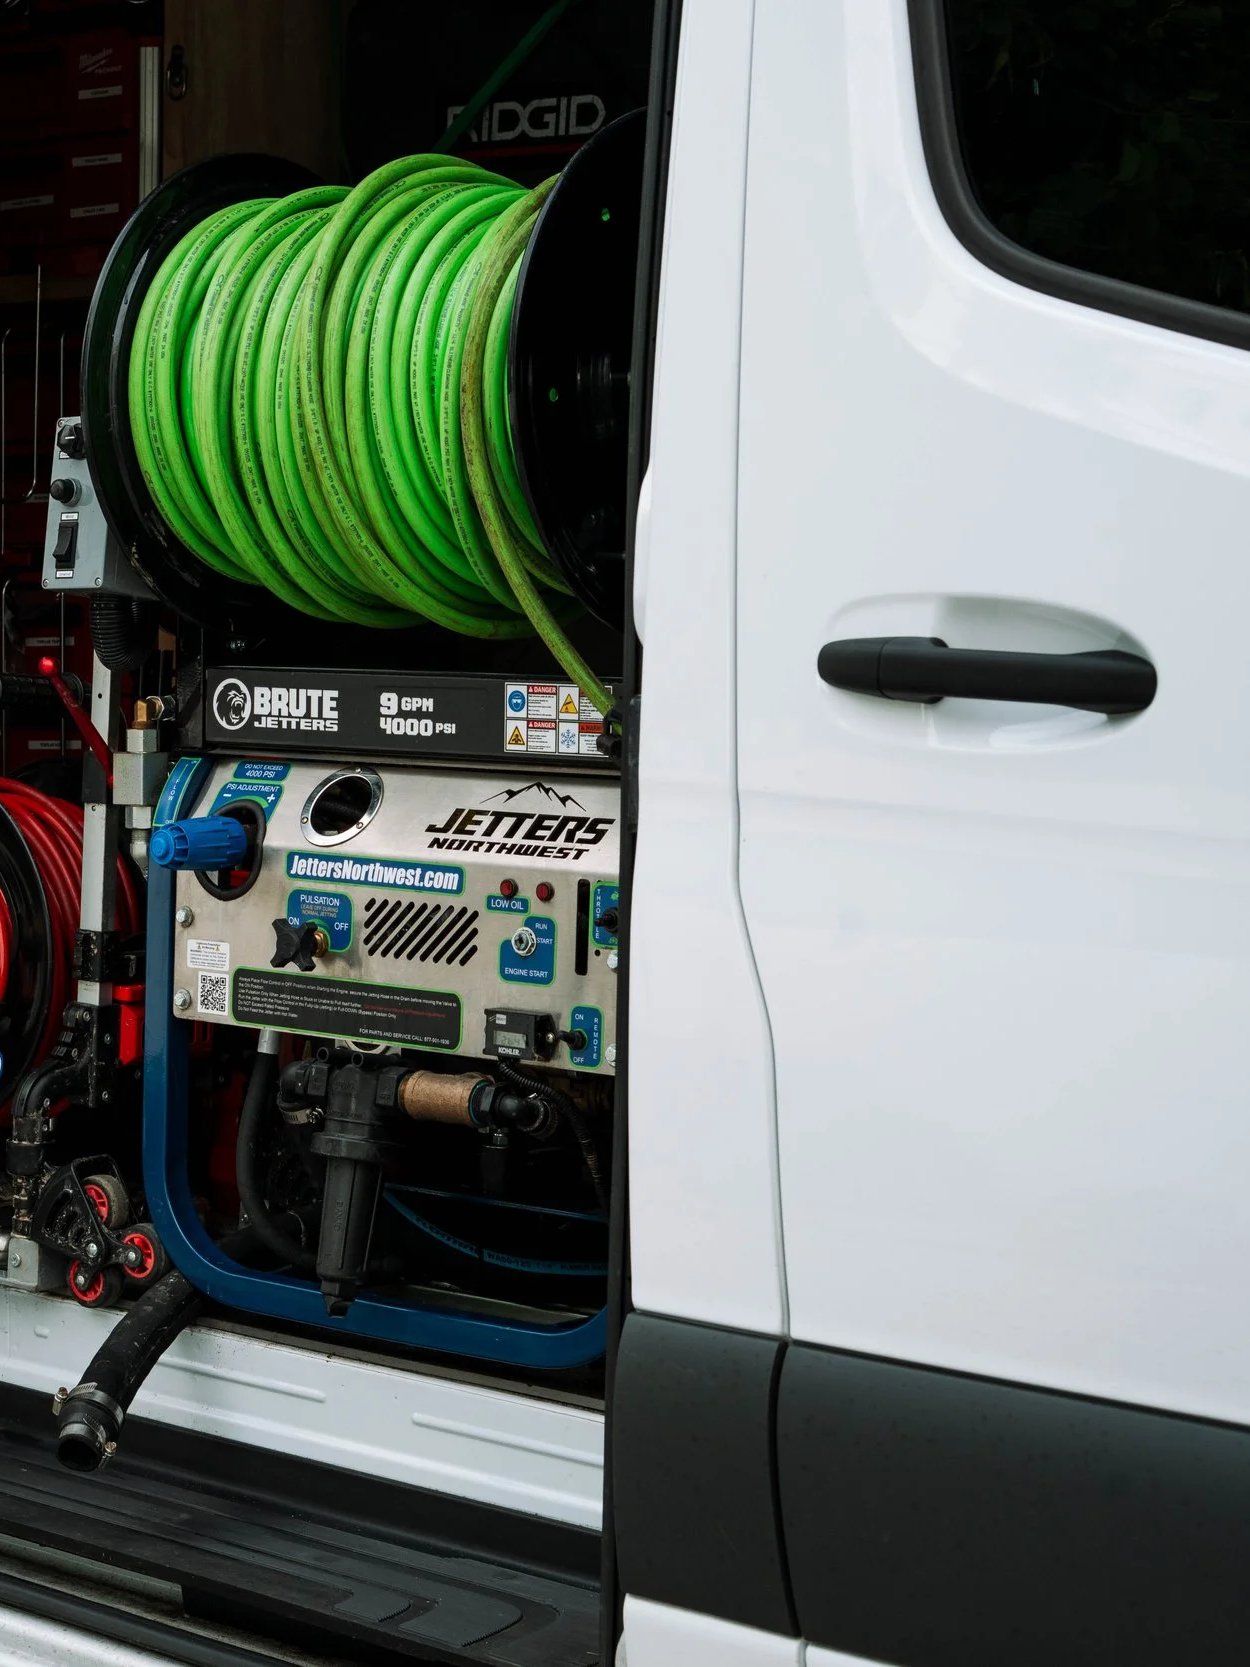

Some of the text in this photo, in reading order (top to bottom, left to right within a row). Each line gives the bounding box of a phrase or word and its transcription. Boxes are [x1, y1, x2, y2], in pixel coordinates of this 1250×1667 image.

[446, 94, 607, 143] RIDGID
[534, 686, 557, 694] DANGER
[254, 686, 339, 719] BRUTE
[379, 692, 434, 716] 9 GPM
[254, 716, 339, 732] JETTERS
[379, 717, 456, 736] 4000 PSI
[534, 721, 556, 729] DANGER
[168, 779, 181, 801] FLOW
[226, 783, 281, 793] PSI ADJUSTMENT
[425, 808, 617, 845] JETTERS
[427, 837, 590, 860] NORTHWEST
[290, 855, 460, 891] JettersNorthwest.com
[300, 894, 340, 907] PULSATION
[491, 899, 524, 910] LOW OIL
[288, 917, 300, 926] ON
[334, 922, 349, 931] OFF
[535, 922, 548, 930] RUN
[536, 937, 553, 945] START
[504, 967, 549, 979] ENGINE START
[574, 1013, 584, 1021] ON
[498, 1046, 520, 1057] KOHLER
[572, 1056, 585, 1064] OFF
